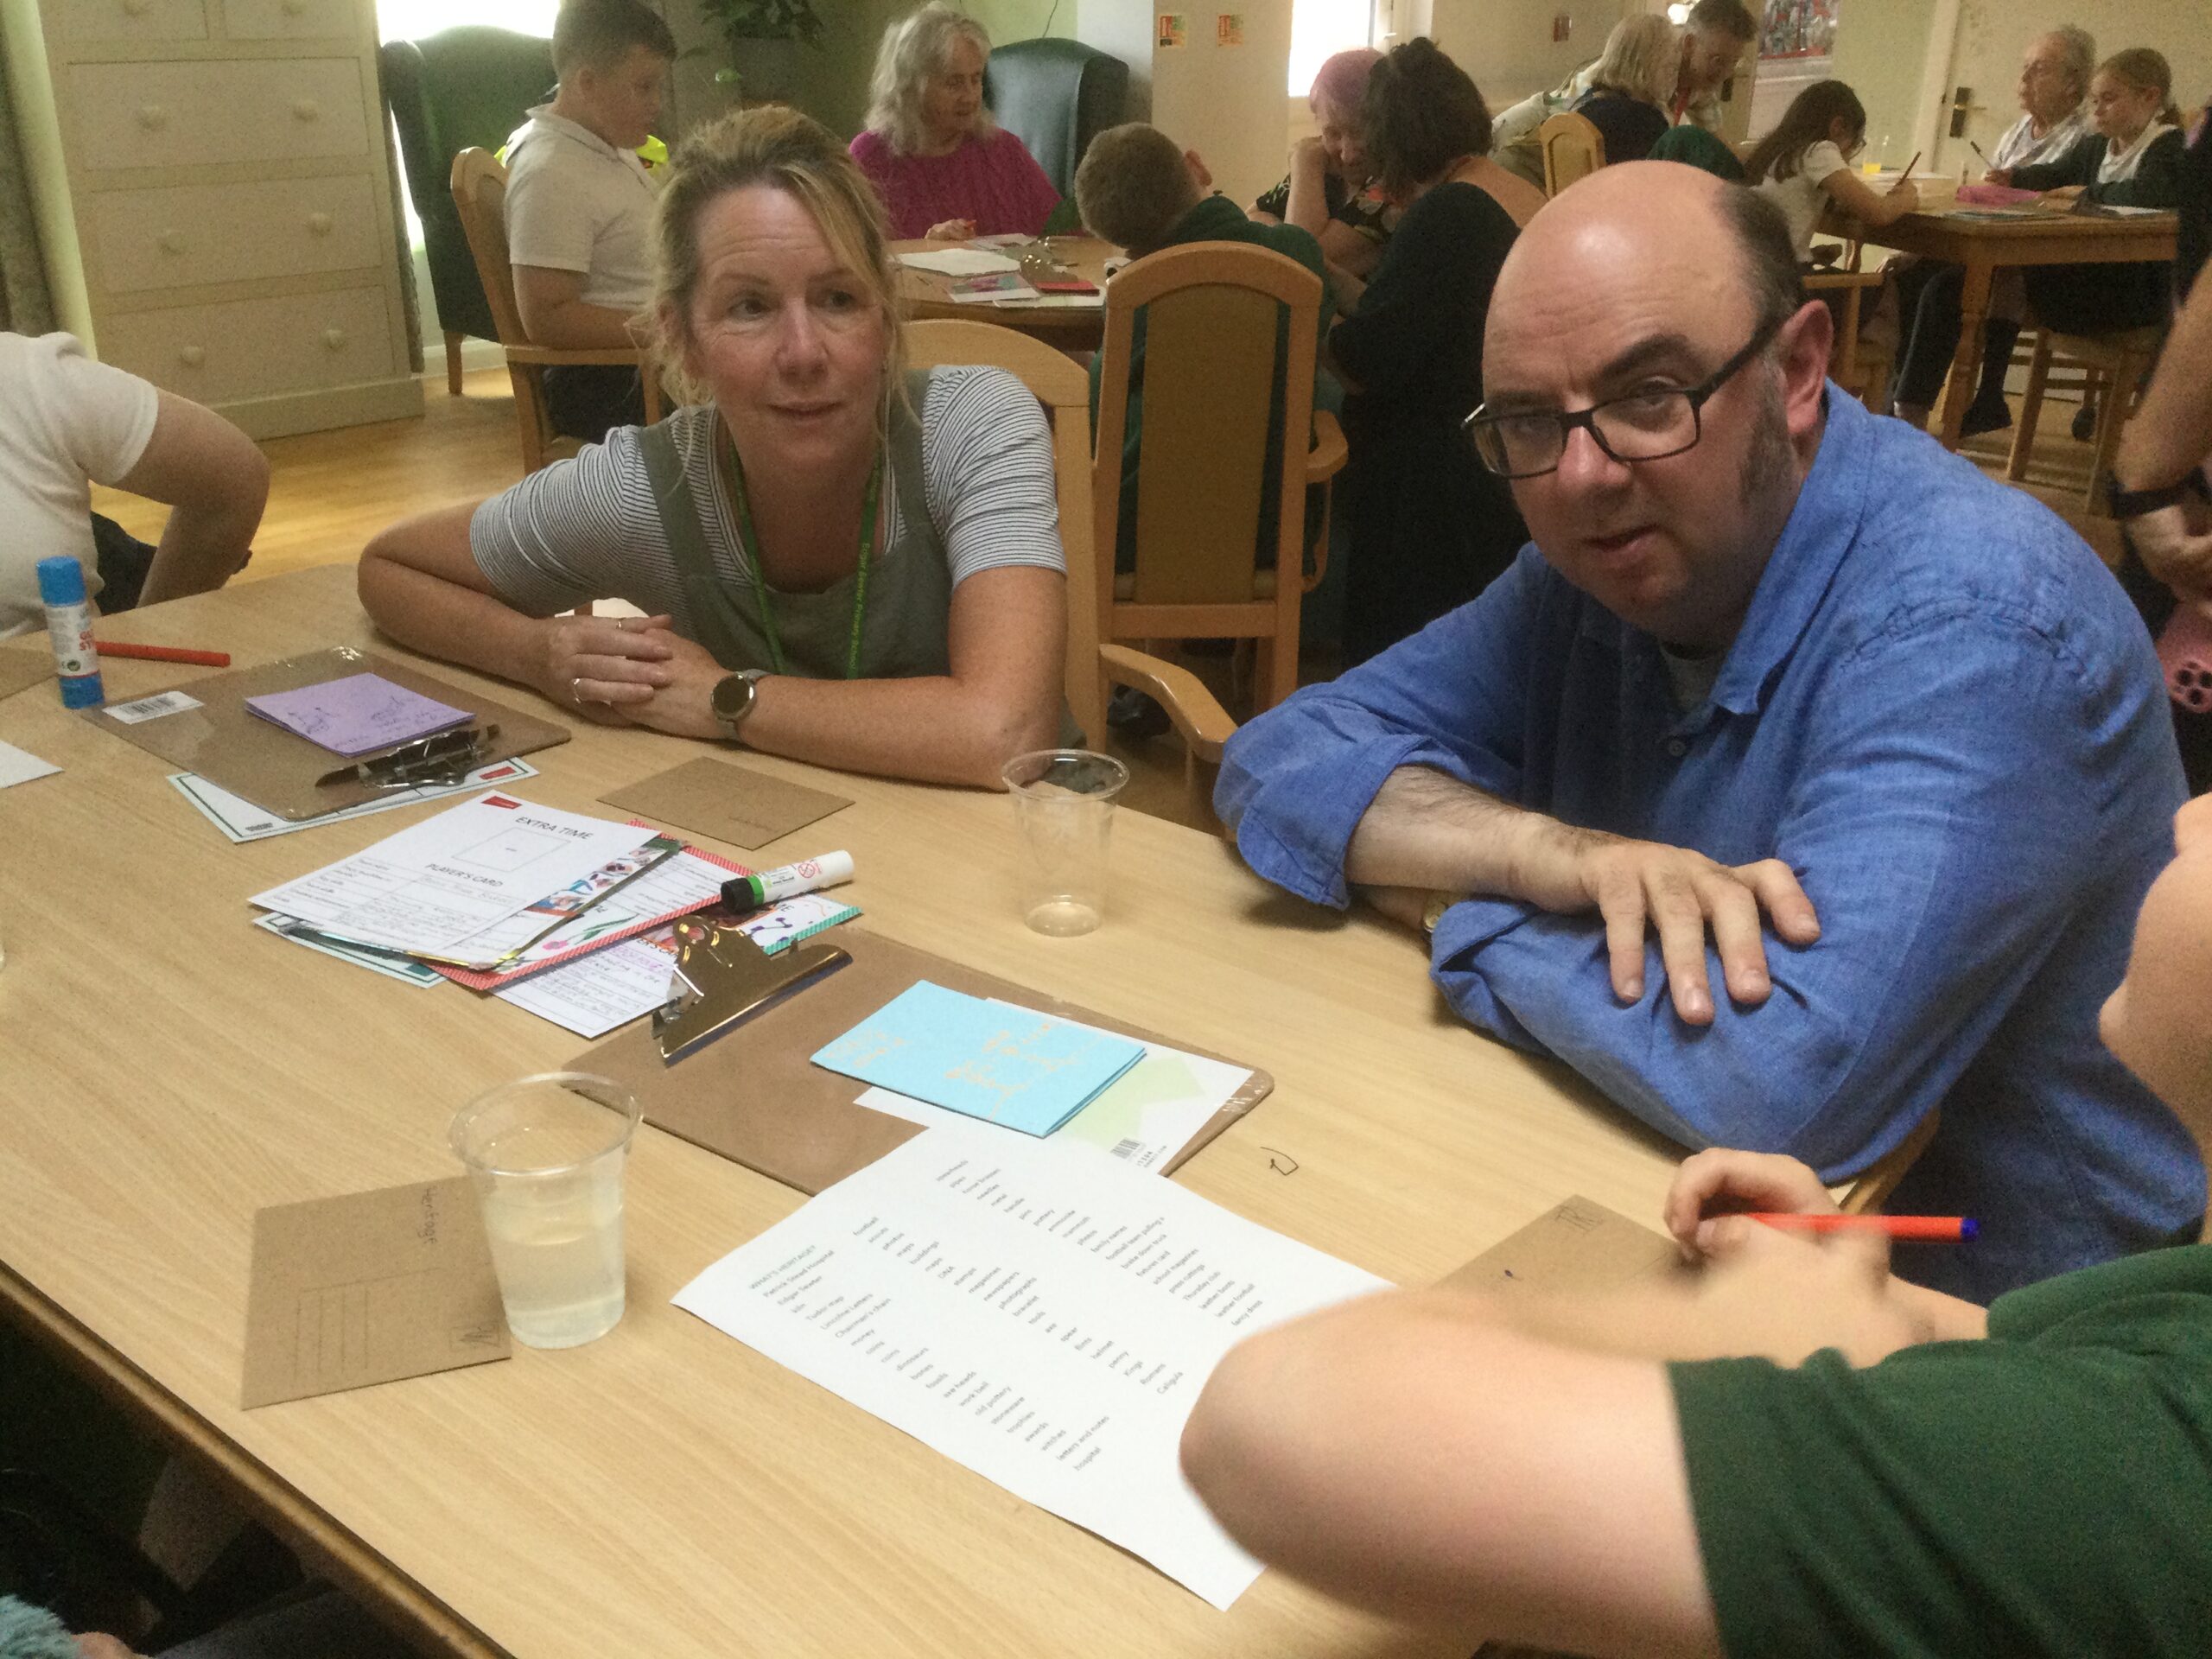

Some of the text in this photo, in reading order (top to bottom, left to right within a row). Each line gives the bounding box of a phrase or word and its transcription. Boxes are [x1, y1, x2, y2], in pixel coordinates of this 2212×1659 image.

[514, 815, 594, 841] EXTRA TIME
[424, 862, 505, 888] PLAYER'S CARD
[949, 1176, 966, 1189] pipes
[962, 1181, 980, 1194] horse
[976, 1184, 1001, 1200] needles
[990, 1193, 1008, 1207] metal
[852, 1216, 879, 1236] football
[1033, 1209, 1056, 1227] pottery
[1047, 1210, 1076, 1233] ammonite
[1062, 1216, 1091, 1238] mammoth
[882, 1232, 906, 1251] photos
[1077, 1230, 1098, 1246] photos
[1090, 1225, 1128, 1253] family names
[1105, 1243, 1129, 1261] football
[1127, 1233, 1143, 1245] team
[1141, 1219, 1163, 1236] pulling
[778, 1244, 816, 1272] HERITAGE?
[896, 1243, 915, 1258] maps
[908, 1241, 940, 1265] buildings
[1137, 1243, 1154, 1257] down
[1157, 1250, 1171, 1262] card
[762, 1281, 788, 1298] Patrick
[805, 1249, 835, 1270] Hospital
[925, 1257, 944, 1273] maps
[937, 1266, 956, 1280] DNA
[1153, 1248, 1199, 1286] school magazines
[953, 1268, 977, 1287] stamps
[968, 1267, 1001, 1294] magazines
[982, 1271, 1020, 1302] newspapers
[1168, 1264, 1206, 1294] press cuttings
[777, 1290, 799, 1306] Edgar
[998, 1277, 1038, 1311] photographs
[1182, 1280, 1211, 1301] Thursday
[1198, 1280, 1236, 1310] leather boots
[1215, 1283, 1255, 1318] leather football
[805, 1296, 844, 1321] Tudor map
[848, 1294, 874, 1311] Letters
[1012, 1294, 1040, 1317] bracelet
[1230, 1300, 1263, 1326] fancy dress
[834, 1298, 892, 1338] Chairman's chain
[1027, 1311, 1046, 1325] tools
[1045, 1323, 1058, 1334] axe
[850, 1328, 875, 1346] money
[1059, 1326, 1077, 1343] spear
[1074, 1337, 1093, 1351] flints
[865, 1340, 886, 1355] coins
[880, 1349, 900, 1363] coins
[1090, 1340, 1115, 1360] helmet
[896, 1347, 930, 1372] dinosaurs
[1108, 1351, 1130, 1370] penny
[1122, 1361, 1143, 1376] Kings
[909, 1363, 934, 1381] bones
[925, 1372, 949, 1389] fossils
[1139, 1363, 1166, 1385] Romans
[943, 1371, 977, 1398] axe heads
[1156, 1371, 1184, 1395] Caligula
[959, 1393, 976, 1408] work
[975, 1386, 1013, 1415] old pottery
[990, 1396, 1026, 1425] stoneware
[1006, 1411, 1036, 1433] trophies
[1024, 1422, 1049, 1443] awards
[1041, 1429, 1067, 1452] witches
[1056, 1416, 1110, 1461] letters and notes
[1072, 1446, 1102, 1471] hospital
